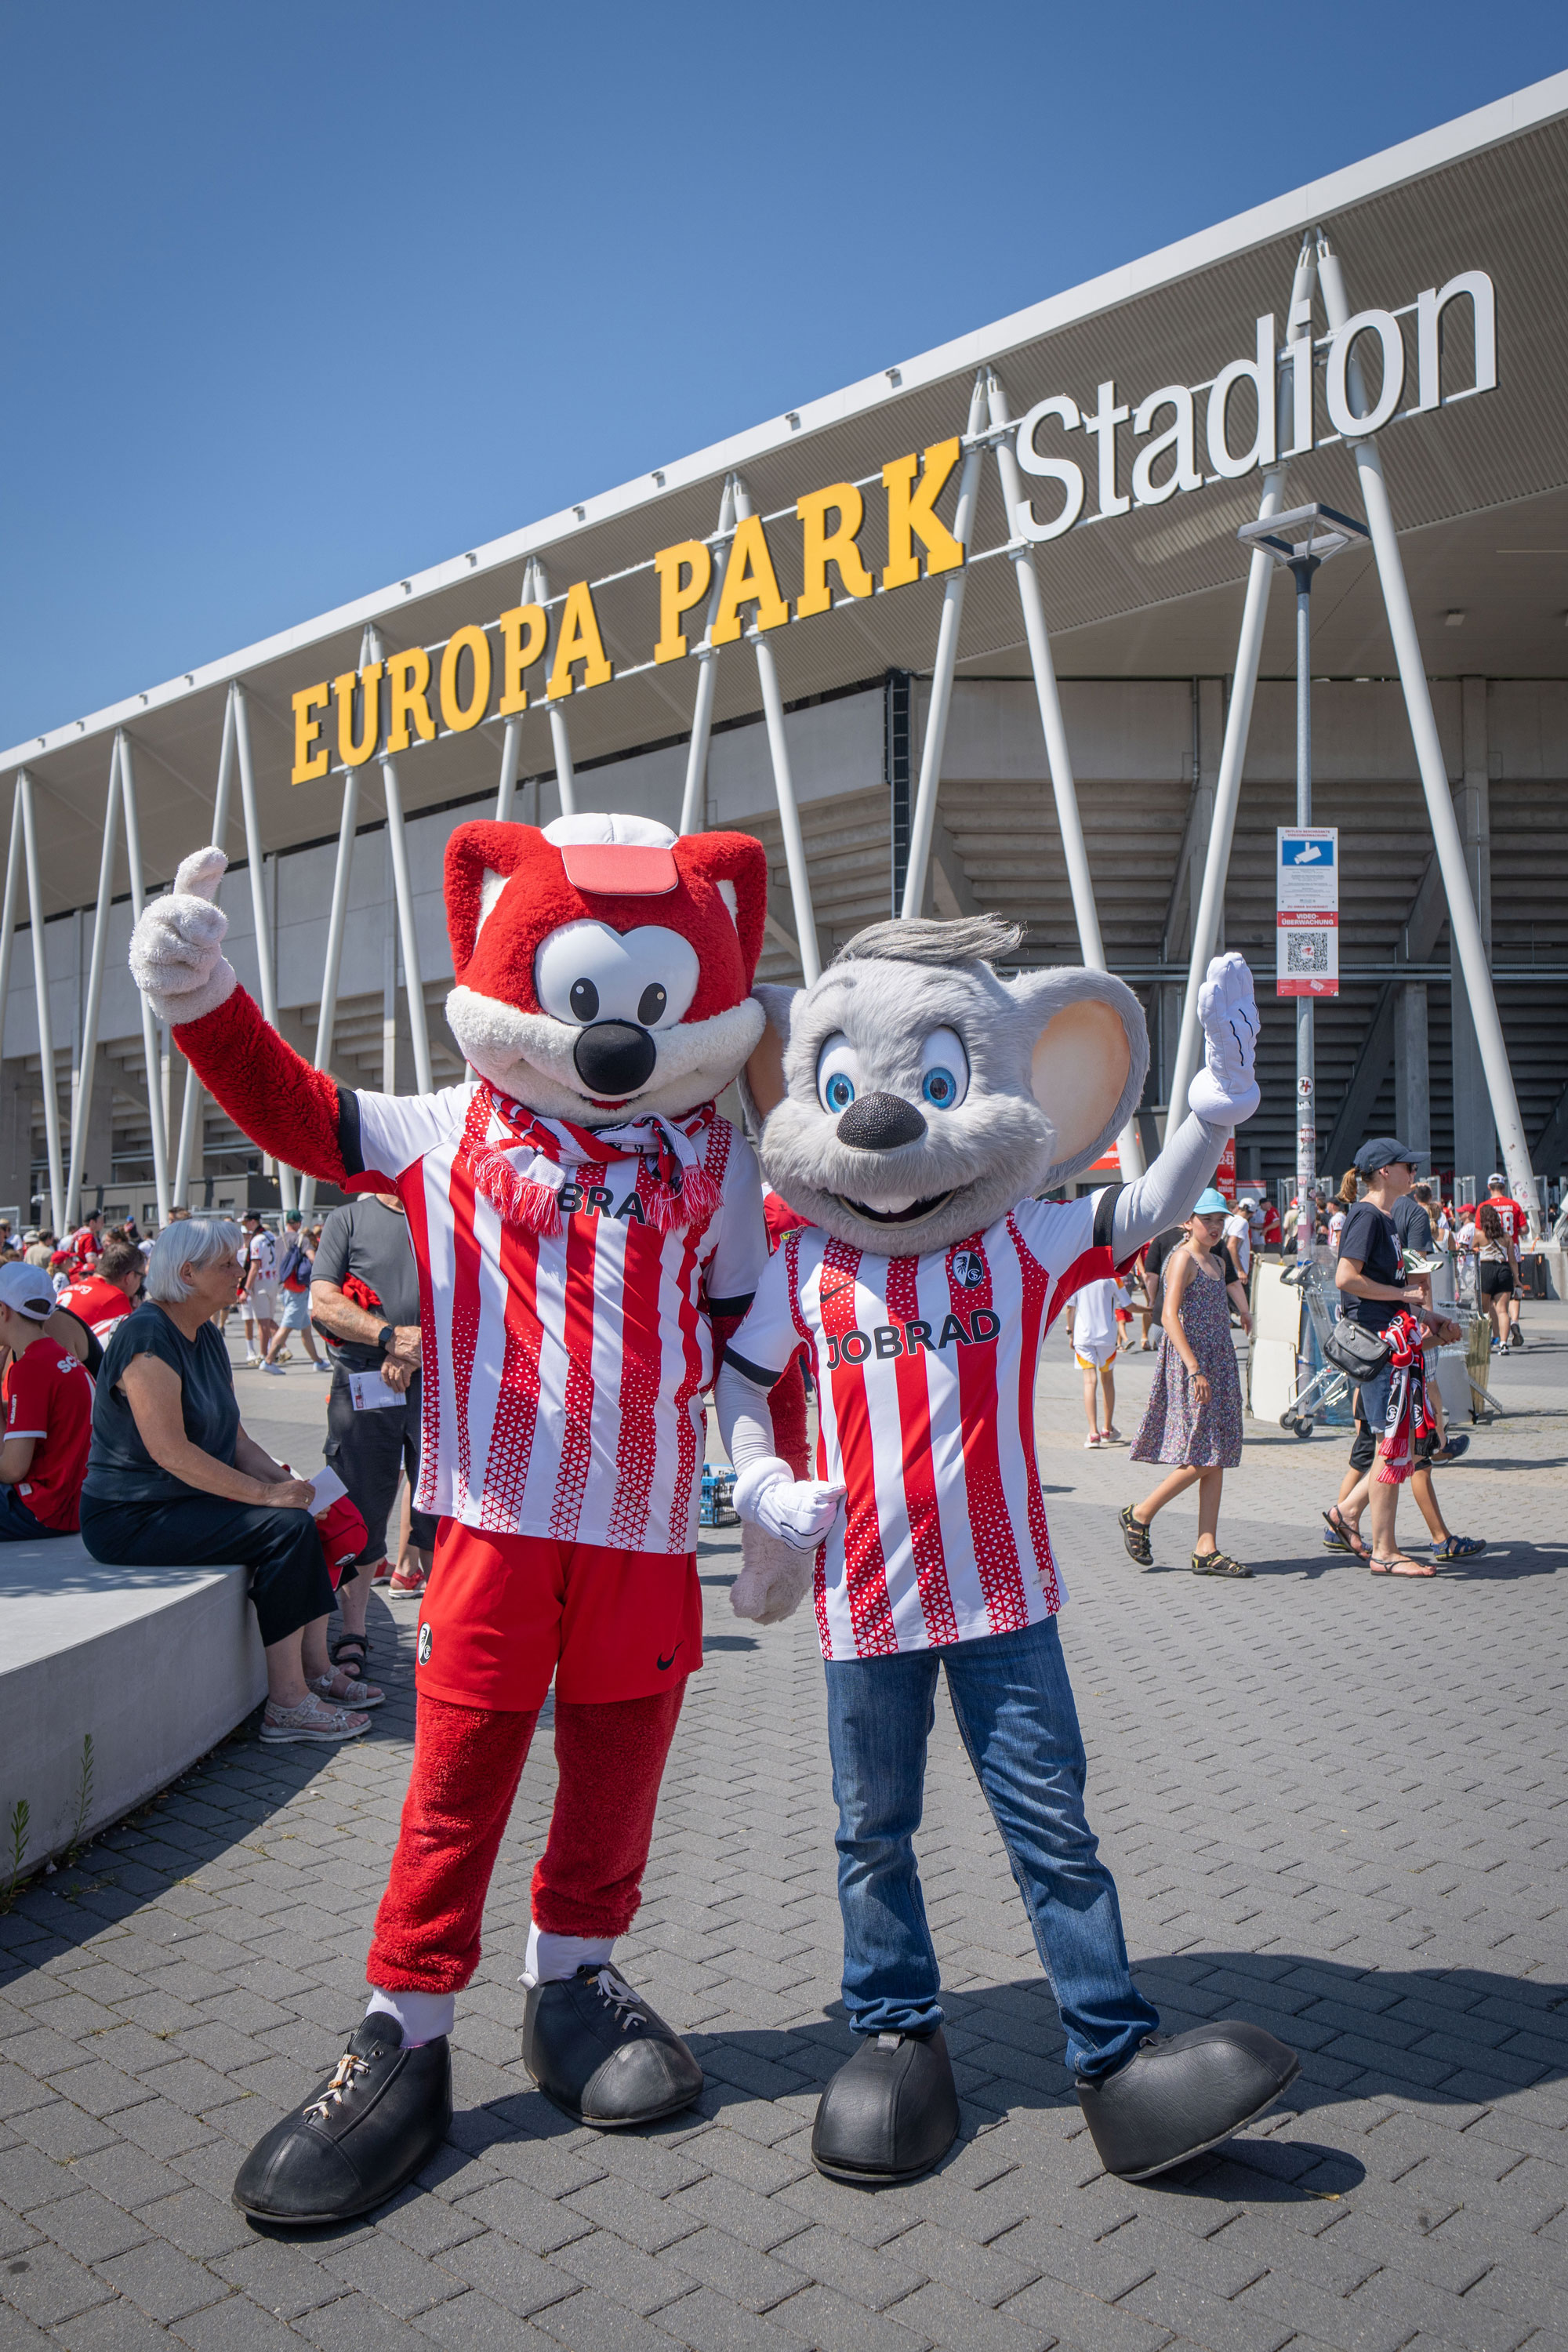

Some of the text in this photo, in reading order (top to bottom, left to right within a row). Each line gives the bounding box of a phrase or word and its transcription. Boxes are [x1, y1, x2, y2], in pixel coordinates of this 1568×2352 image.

[290, 270, 1499, 786] EUROPA PARK Stadion
[557, 1182, 661, 1230] BRA
[826, 1308, 1001, 1370] JOBRAD
